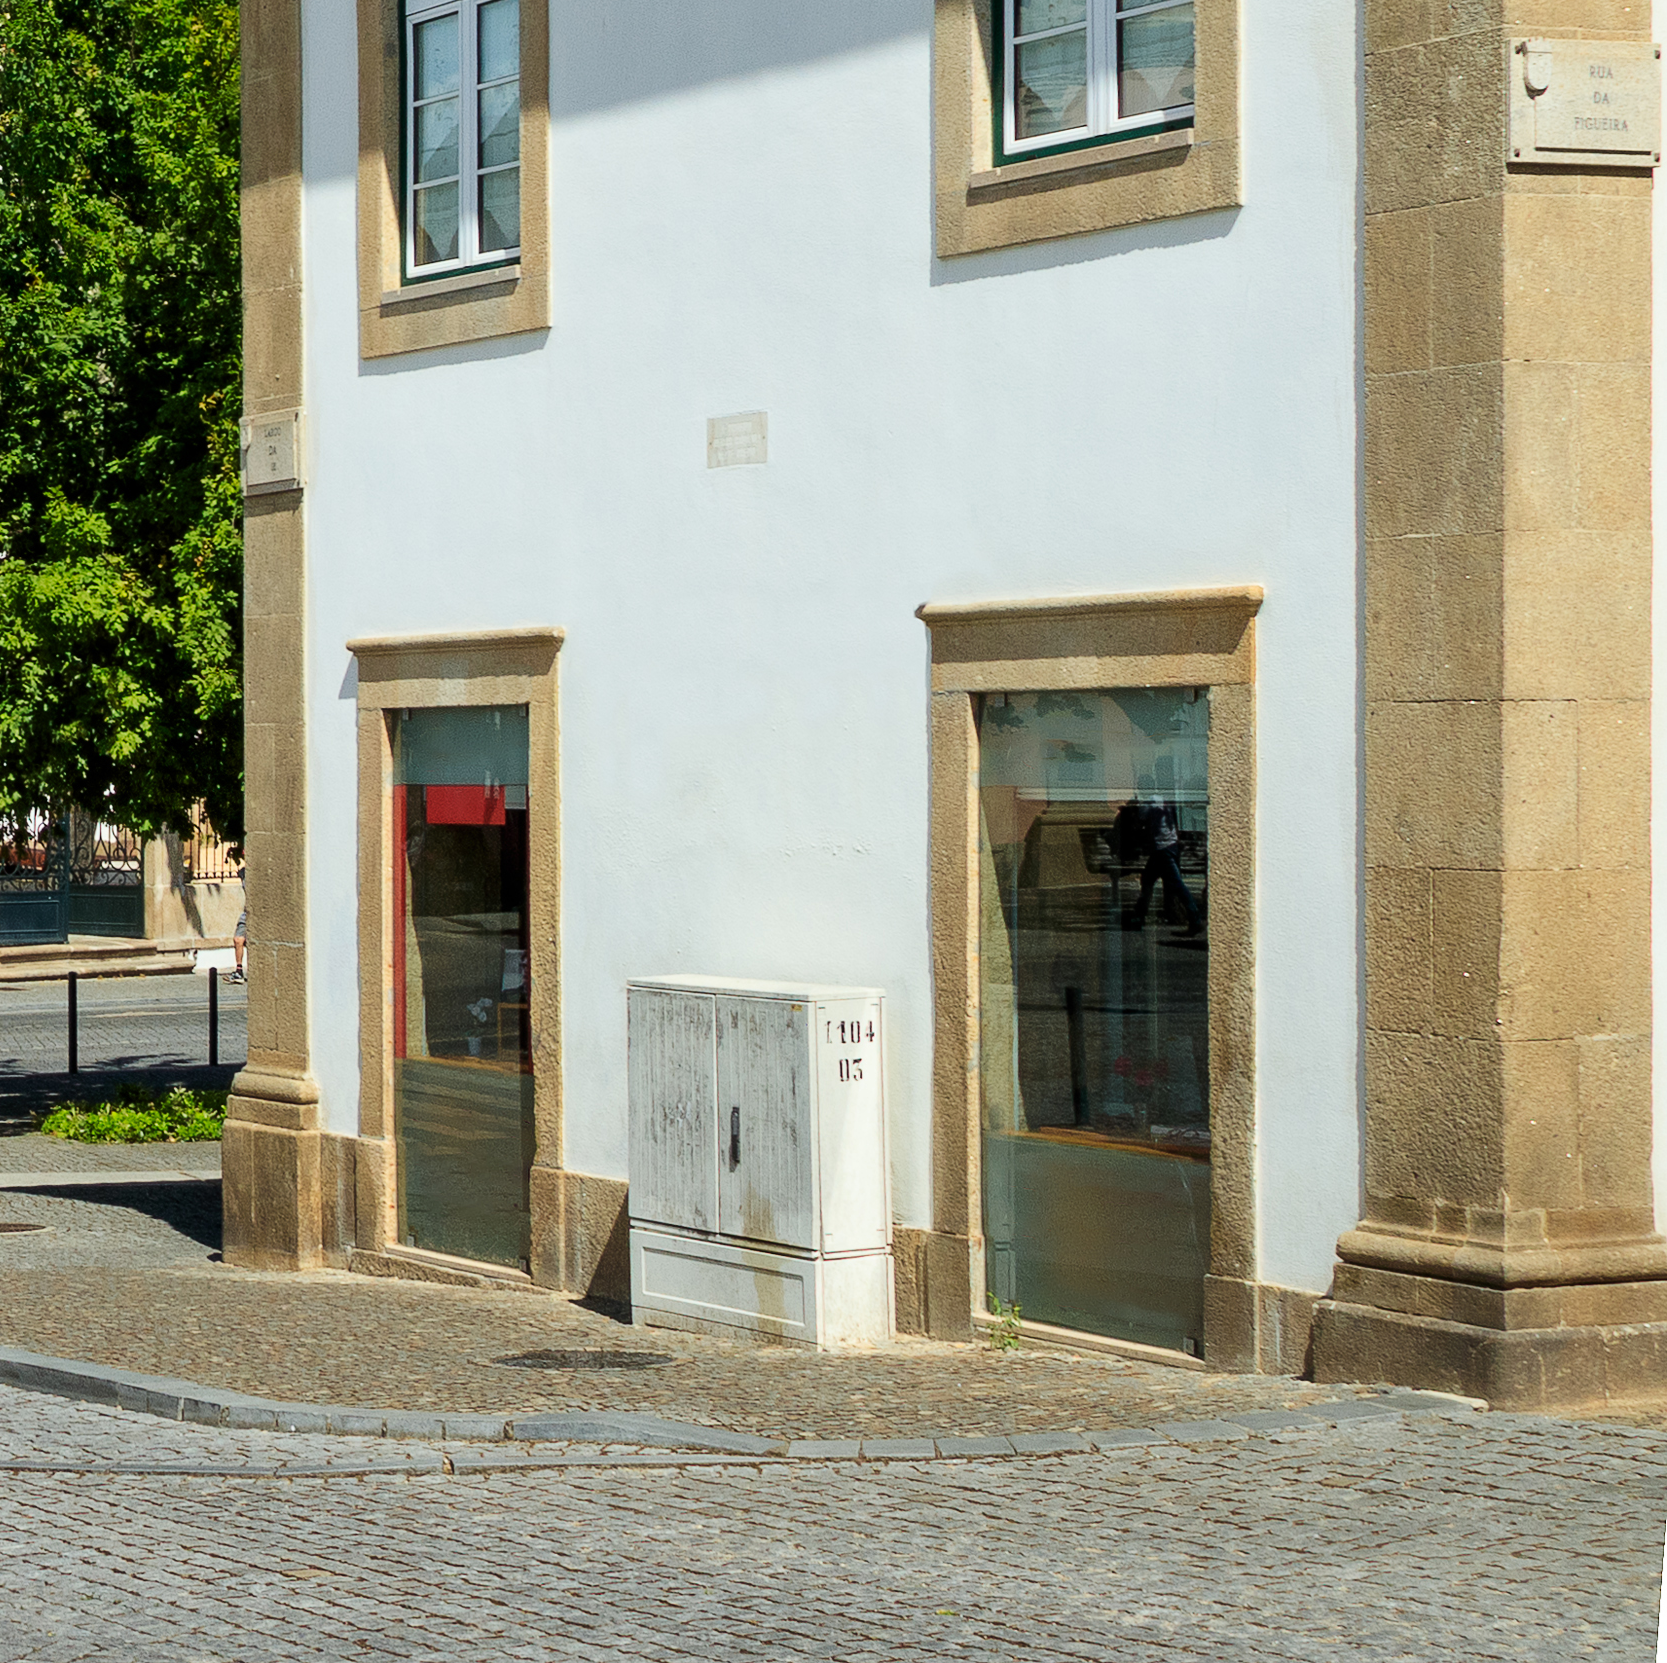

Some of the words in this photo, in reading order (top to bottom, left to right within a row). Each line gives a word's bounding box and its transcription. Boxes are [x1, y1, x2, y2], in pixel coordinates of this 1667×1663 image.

[1589, 65, 1613, 79] RUA
[1593, 91, 1610, 104] DA
[1574, 116, 1629, 132] FIGUEIRA
